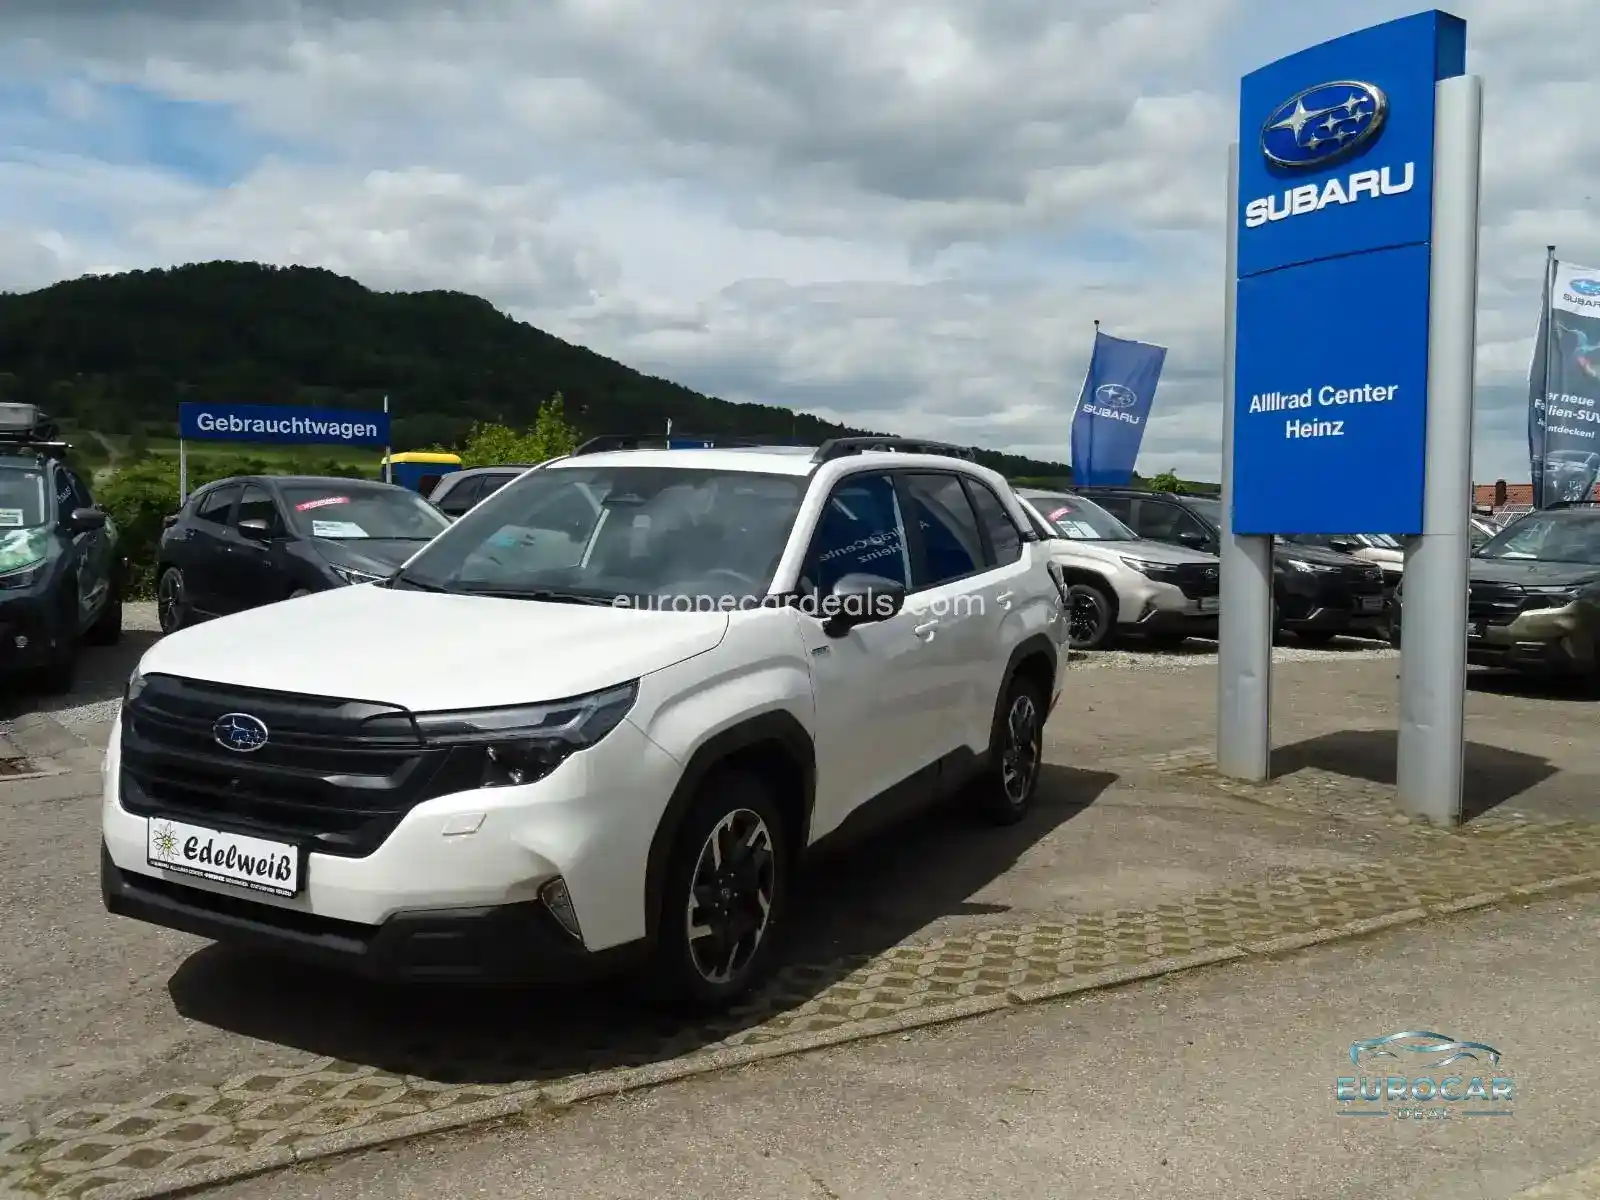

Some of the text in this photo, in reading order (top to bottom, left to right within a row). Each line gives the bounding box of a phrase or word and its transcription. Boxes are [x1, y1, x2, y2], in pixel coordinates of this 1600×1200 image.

[1245, 161, 1415, 228] SUBARU
[1563, 293, 1600, 307] SUBAR
[1318, 383, 1398, 406] Center
[1561, 394, 1594, 407] neue
[1082, 403, 1140, 425] SUBARU
[197, 412, 377, 439] Gebrauchtwagen
[1285, 418, 1345, 439] Heinz
[183, 836, 292, 881] Edelweiß
